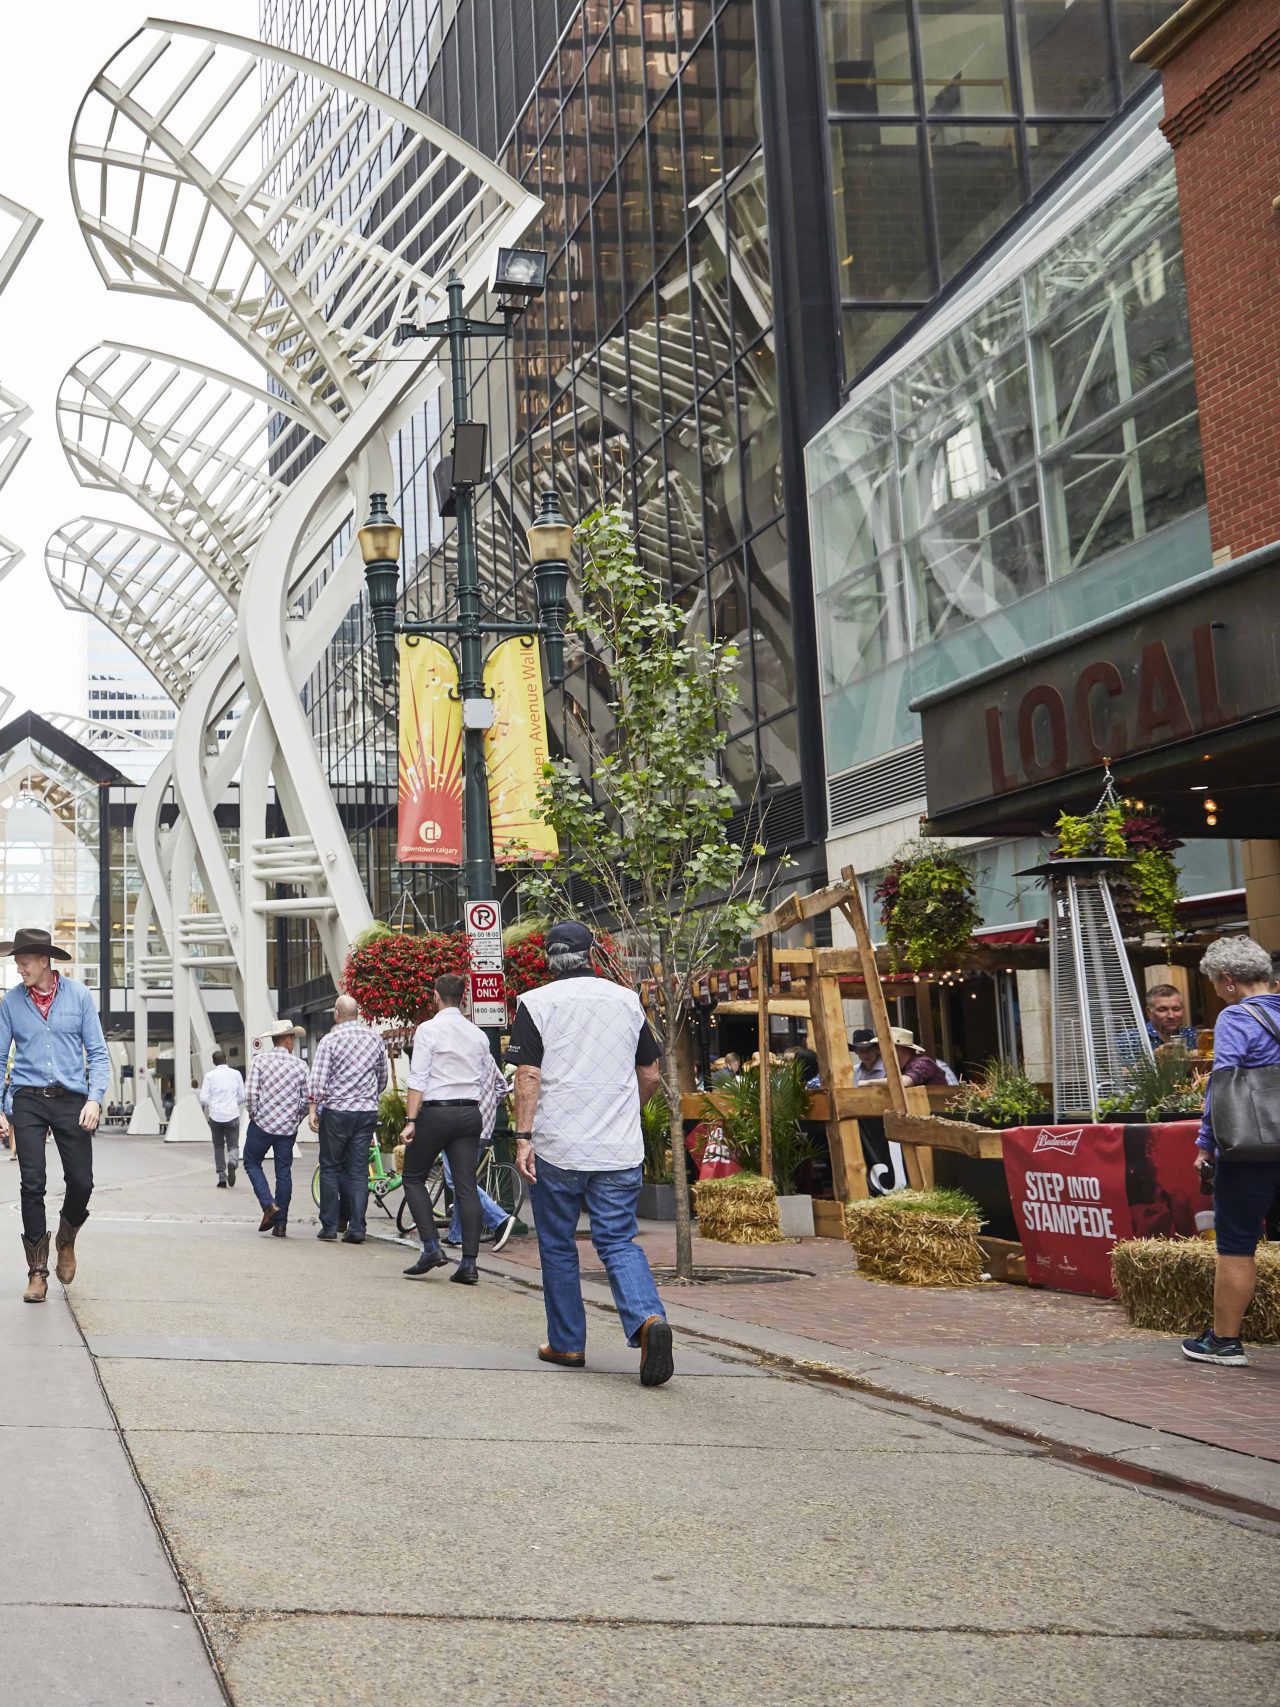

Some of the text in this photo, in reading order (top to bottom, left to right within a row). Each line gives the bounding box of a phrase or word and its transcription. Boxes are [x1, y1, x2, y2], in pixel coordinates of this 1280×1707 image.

[527, 683, 541, 741] Avenue
[985, 623, 1241, 795] LOCAL
[401, 844, 459, 855] downtown calgary
[476, 977, 498, 987] TAXI
[476, 988, 500, 998] ONLY
[1025, 1171, 1101, 1203] STEP INTO
[1022, 1200, 1117, 1240] STAMPEDE
